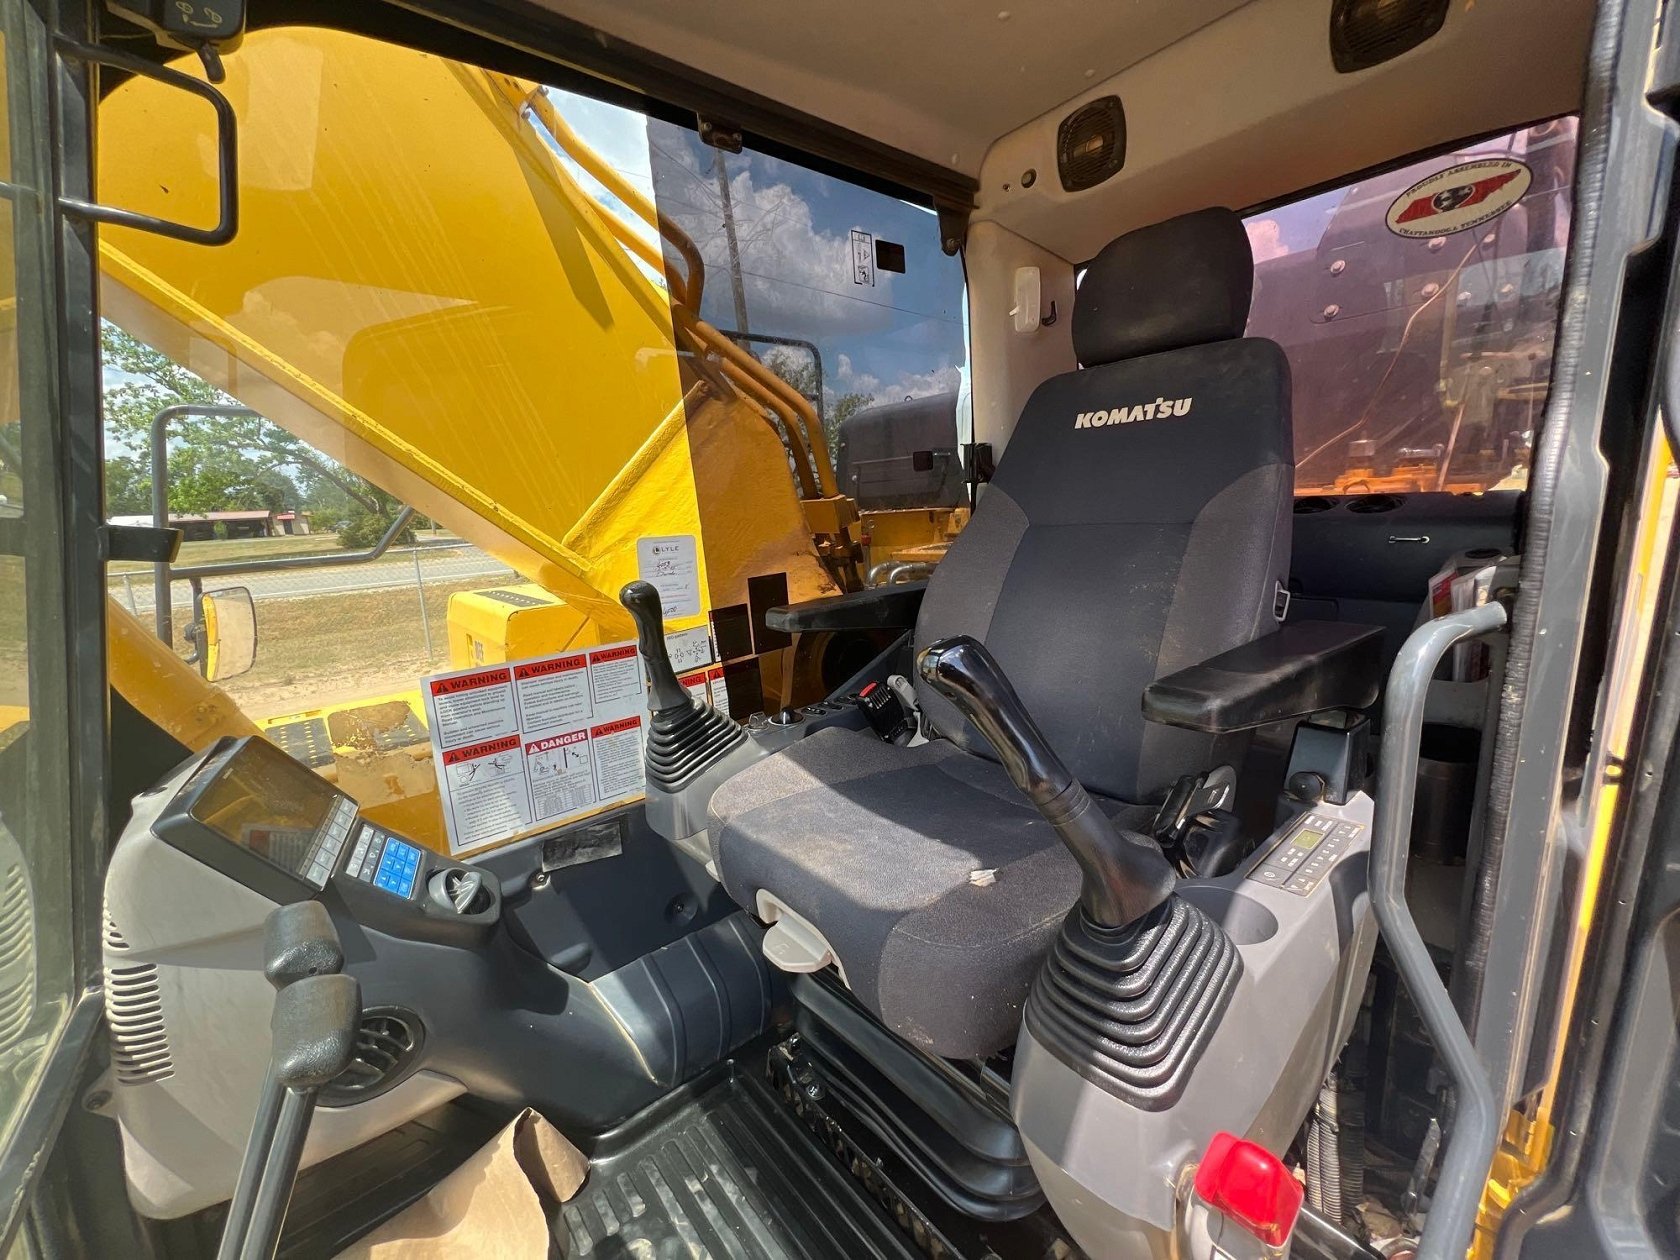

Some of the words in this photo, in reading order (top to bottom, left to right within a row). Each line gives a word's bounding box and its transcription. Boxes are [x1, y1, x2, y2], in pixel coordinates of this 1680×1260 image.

[1405, 174, 1444, 197] PROUDLY
[1448, 162, 1499, 175] ASSEMBLED
[1461, 201, 1512, 229] TENNESSEE
[1074, 397, 1192, 429] KOMATSU
[600, 647, 636, 660] WARNING
[531, 658, 581, 674] WARNING
[450, 672, 507, 689] WARNING
[603, 719, 638, 734] WARNING
[462, 738, 517, 758] WARNING
[540, 731, 587, 750] DANGER
